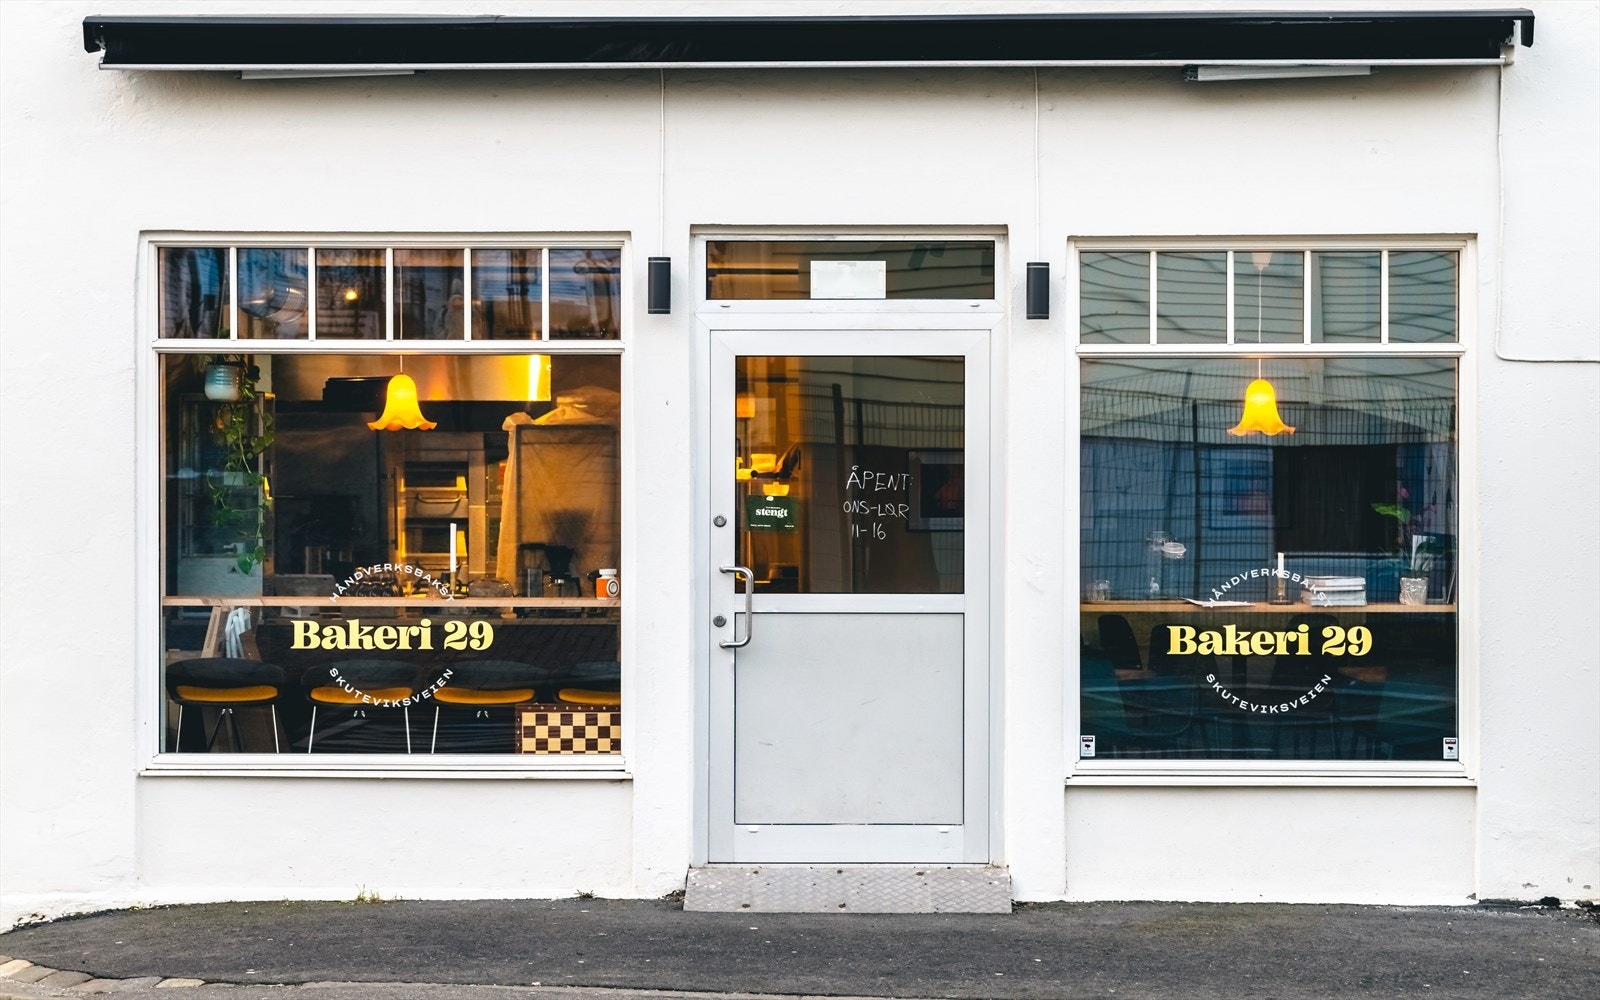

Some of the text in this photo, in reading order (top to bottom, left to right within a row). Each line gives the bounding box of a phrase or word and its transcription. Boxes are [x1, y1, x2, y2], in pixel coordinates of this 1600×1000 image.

[755, 508, 788, 518] stengt
[328, 563, 456, 603] HÅNDVERKSBAKST
[290, 618, 495, 651] Bakeri 29
[1166, 623, 1374, 657] Bakeri 29
[329, 667, 455, 708] SKUTEVIKSVEIEN
[1206, 673, 1333, 714] SKUTEVIKSVEIEN
